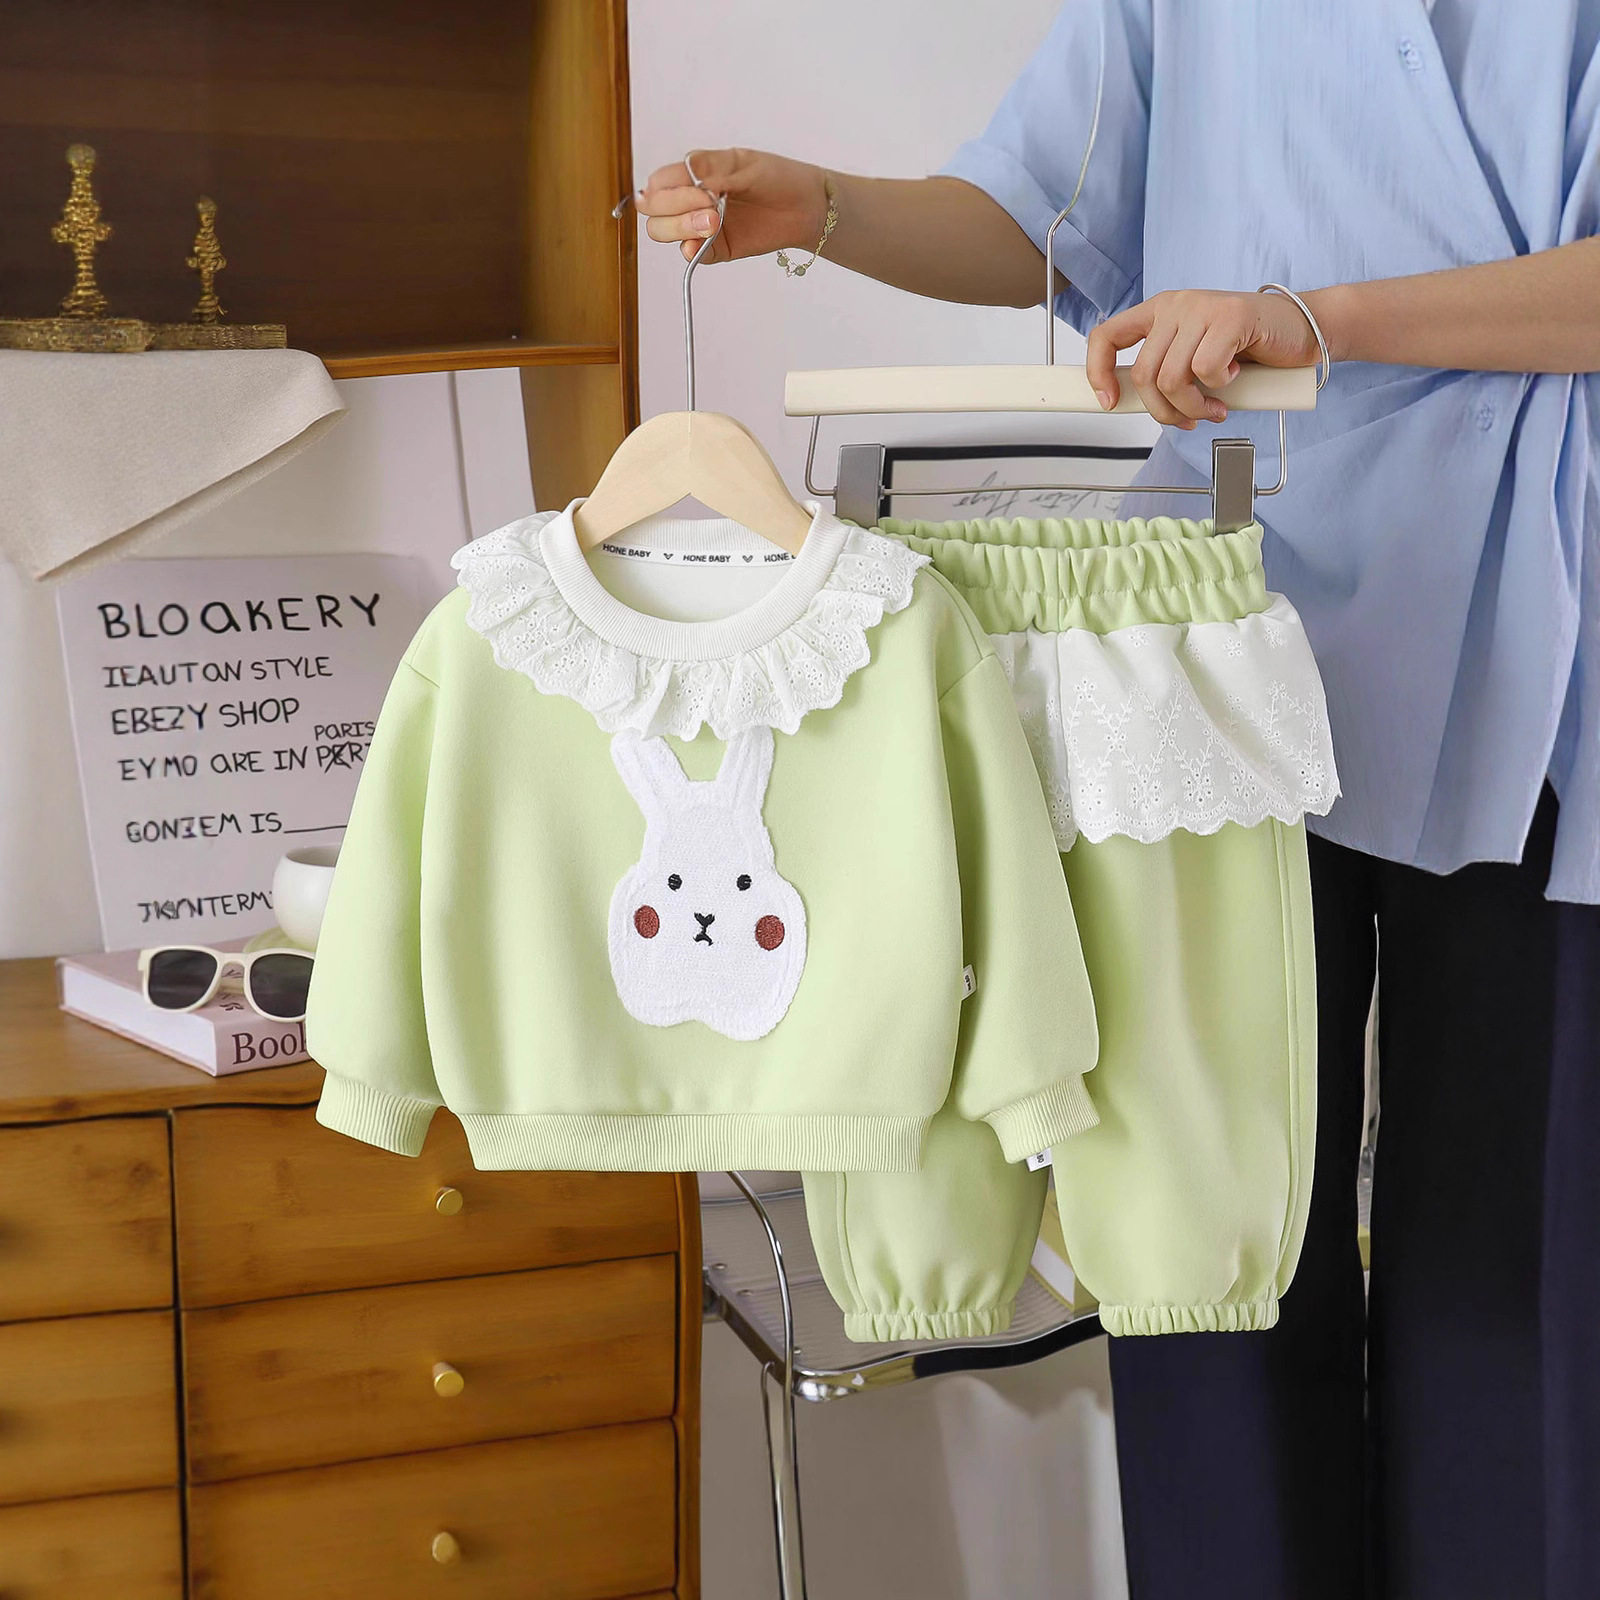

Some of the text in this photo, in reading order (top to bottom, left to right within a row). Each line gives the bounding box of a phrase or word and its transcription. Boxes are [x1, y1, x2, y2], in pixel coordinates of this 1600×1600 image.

[603, 543, 790, 563] HONE BABY HONE BABY HONE
[250, 656, 334, 681] STYLE
[219, 697, 300, 728] SHOP
[273, 746, 308, 771] IN
